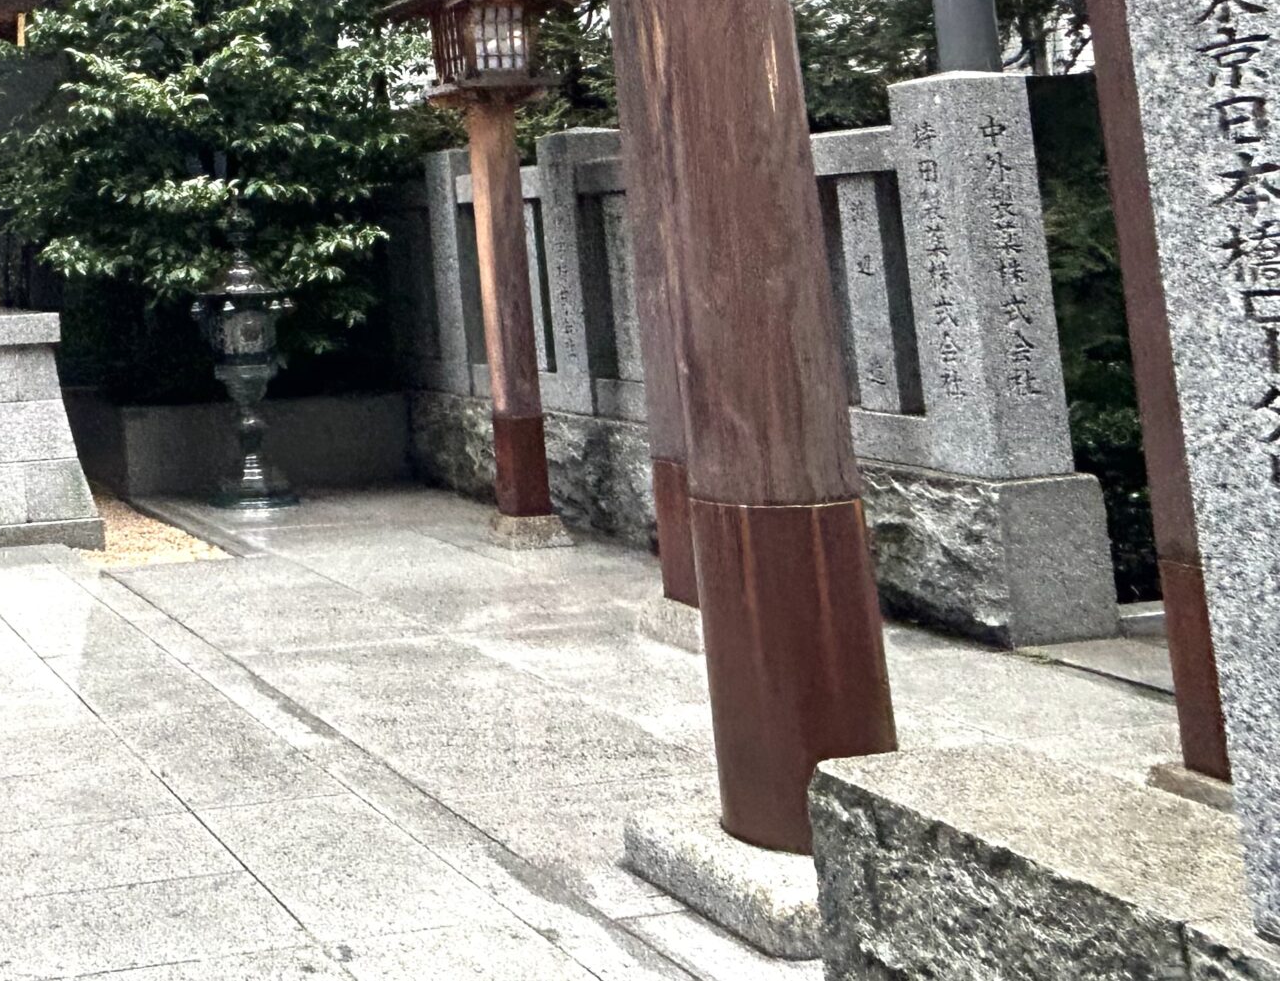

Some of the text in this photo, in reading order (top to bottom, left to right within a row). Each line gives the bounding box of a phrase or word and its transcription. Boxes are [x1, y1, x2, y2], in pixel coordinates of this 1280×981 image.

[912, 121, 967, 397] 持田製薬株式会社
[979, 114, 1042, 396] 中外製薬株式会社
